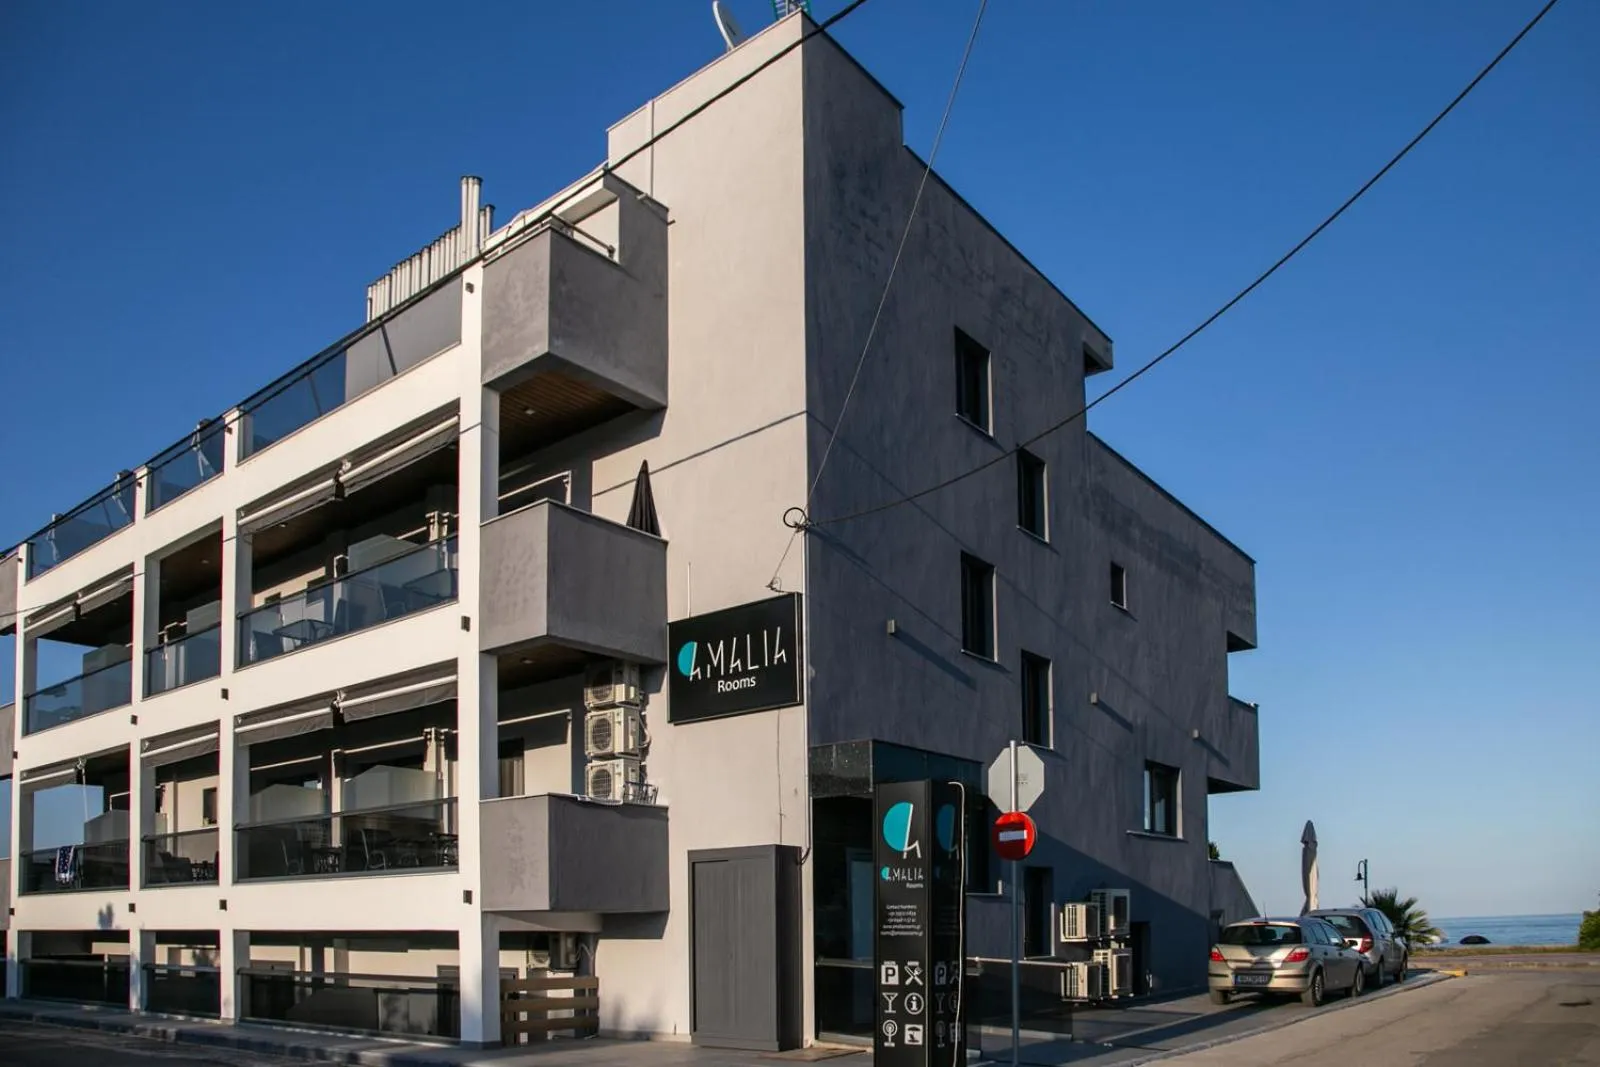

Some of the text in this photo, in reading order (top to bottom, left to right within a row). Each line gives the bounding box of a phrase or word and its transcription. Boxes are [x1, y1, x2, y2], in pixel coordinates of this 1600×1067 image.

[678, 626, 787, 682] AMALIA
[717, 676, 756, 693] Rooms
[880, 866, 924, 881] AMALIA
